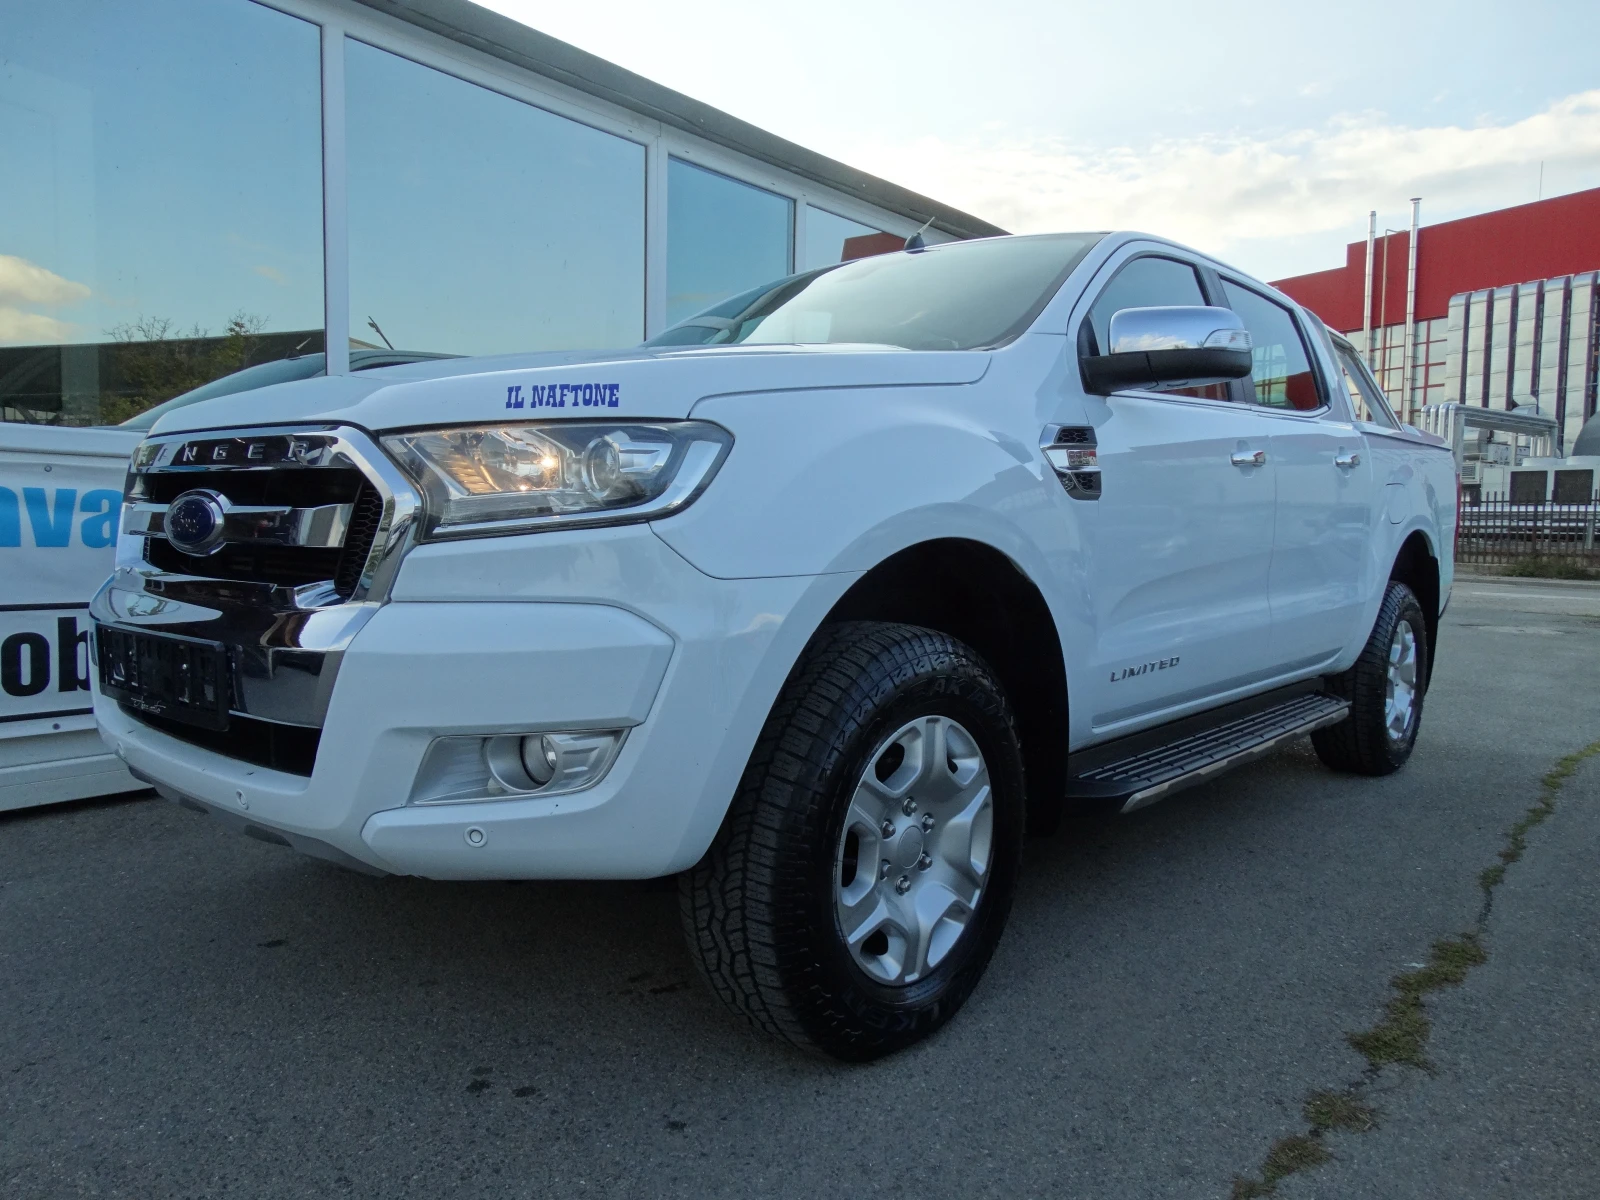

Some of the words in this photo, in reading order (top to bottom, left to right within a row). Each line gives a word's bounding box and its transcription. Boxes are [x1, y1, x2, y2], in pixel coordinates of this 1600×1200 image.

[506, 385, 525, 409] IL
[531, 383, 620, 409] NAFTONE
[1110, 655, 1180, 683] LIMITED
